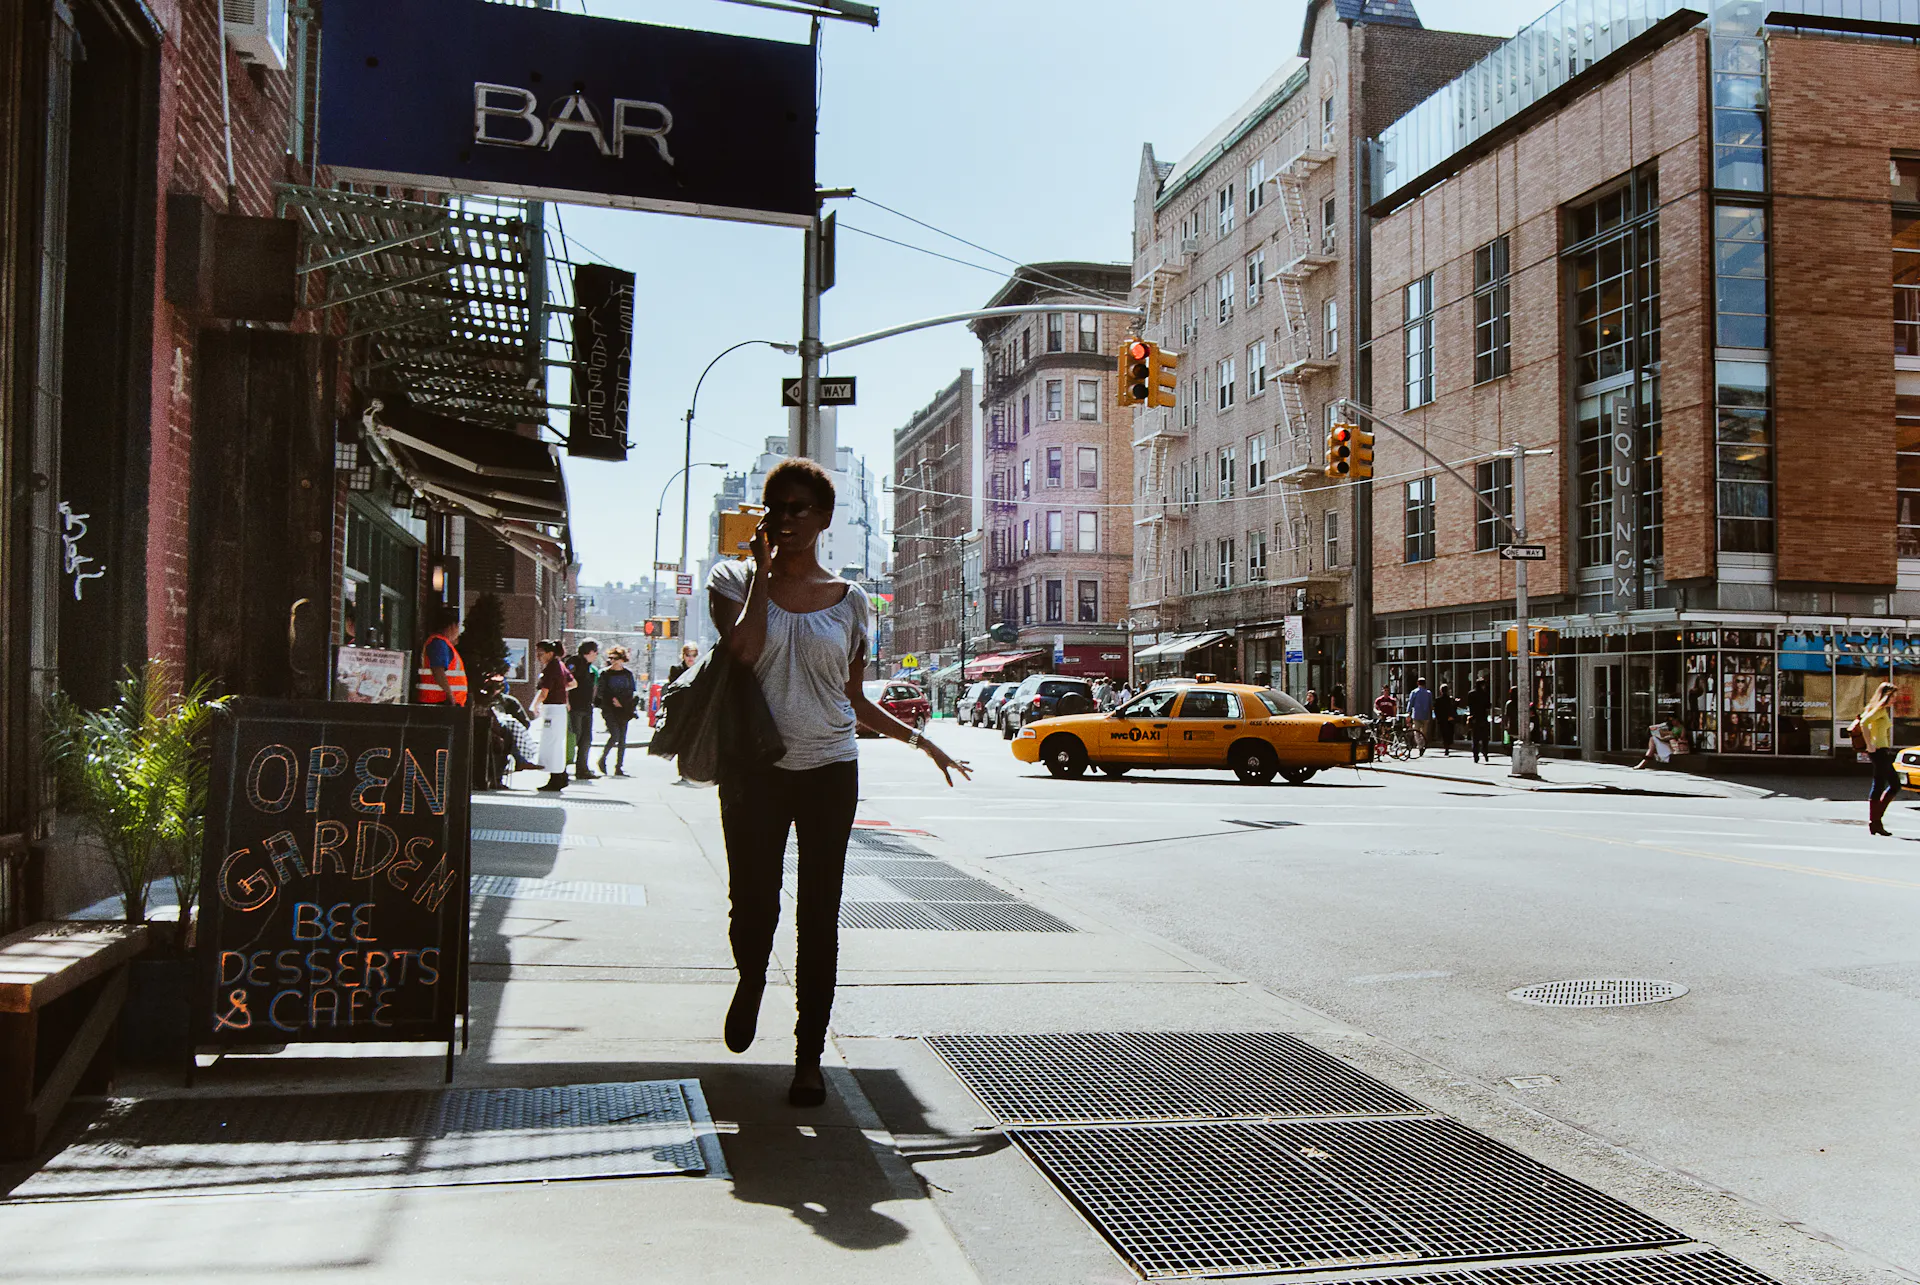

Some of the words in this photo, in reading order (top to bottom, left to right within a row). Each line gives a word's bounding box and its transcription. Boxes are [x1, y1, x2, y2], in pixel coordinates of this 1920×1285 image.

[474, 81, 674, 166] BAR
[823, 385, 846, 397] WAY
[1614, 404, 1632, 597] EQUINOX
[1560, 627, 1603, 639] FITNESS
[1776, 624, 1889, 639] EQUINOX
[1129, 728, 1160, 741] TAXI
[246, 744, 449, 815] OPEN
[218, 820, 457, 912] GARDEN
[292, 902, 377, 942] BEE
[221, 948, 440, 987] DESSERTS
[213, 989, 251, 1032] &
[269, 989, 396, 1031] CAFE
